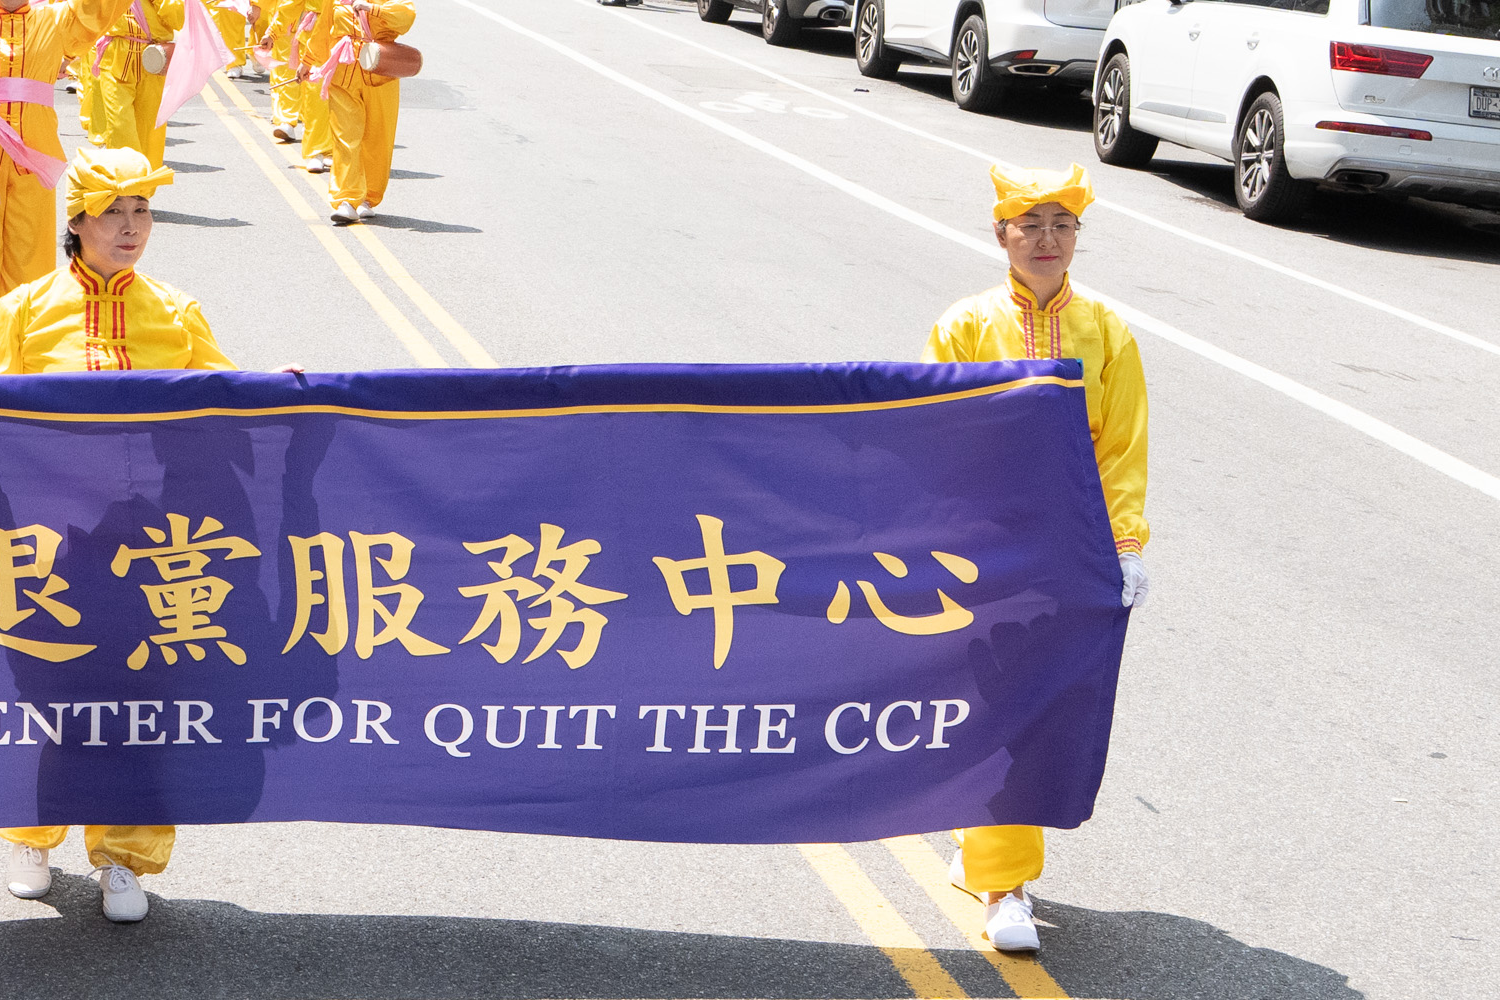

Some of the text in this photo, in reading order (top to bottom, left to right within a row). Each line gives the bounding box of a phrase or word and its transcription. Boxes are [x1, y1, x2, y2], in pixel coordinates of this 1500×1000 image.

[1476, 97, 1492, 110] DUP
[246, 696, 400, 746] FOR
[423, 703, 617, 759] QUIT
[639, 703, 797, 755] THE
[825, 699, 970, 756] CCP
